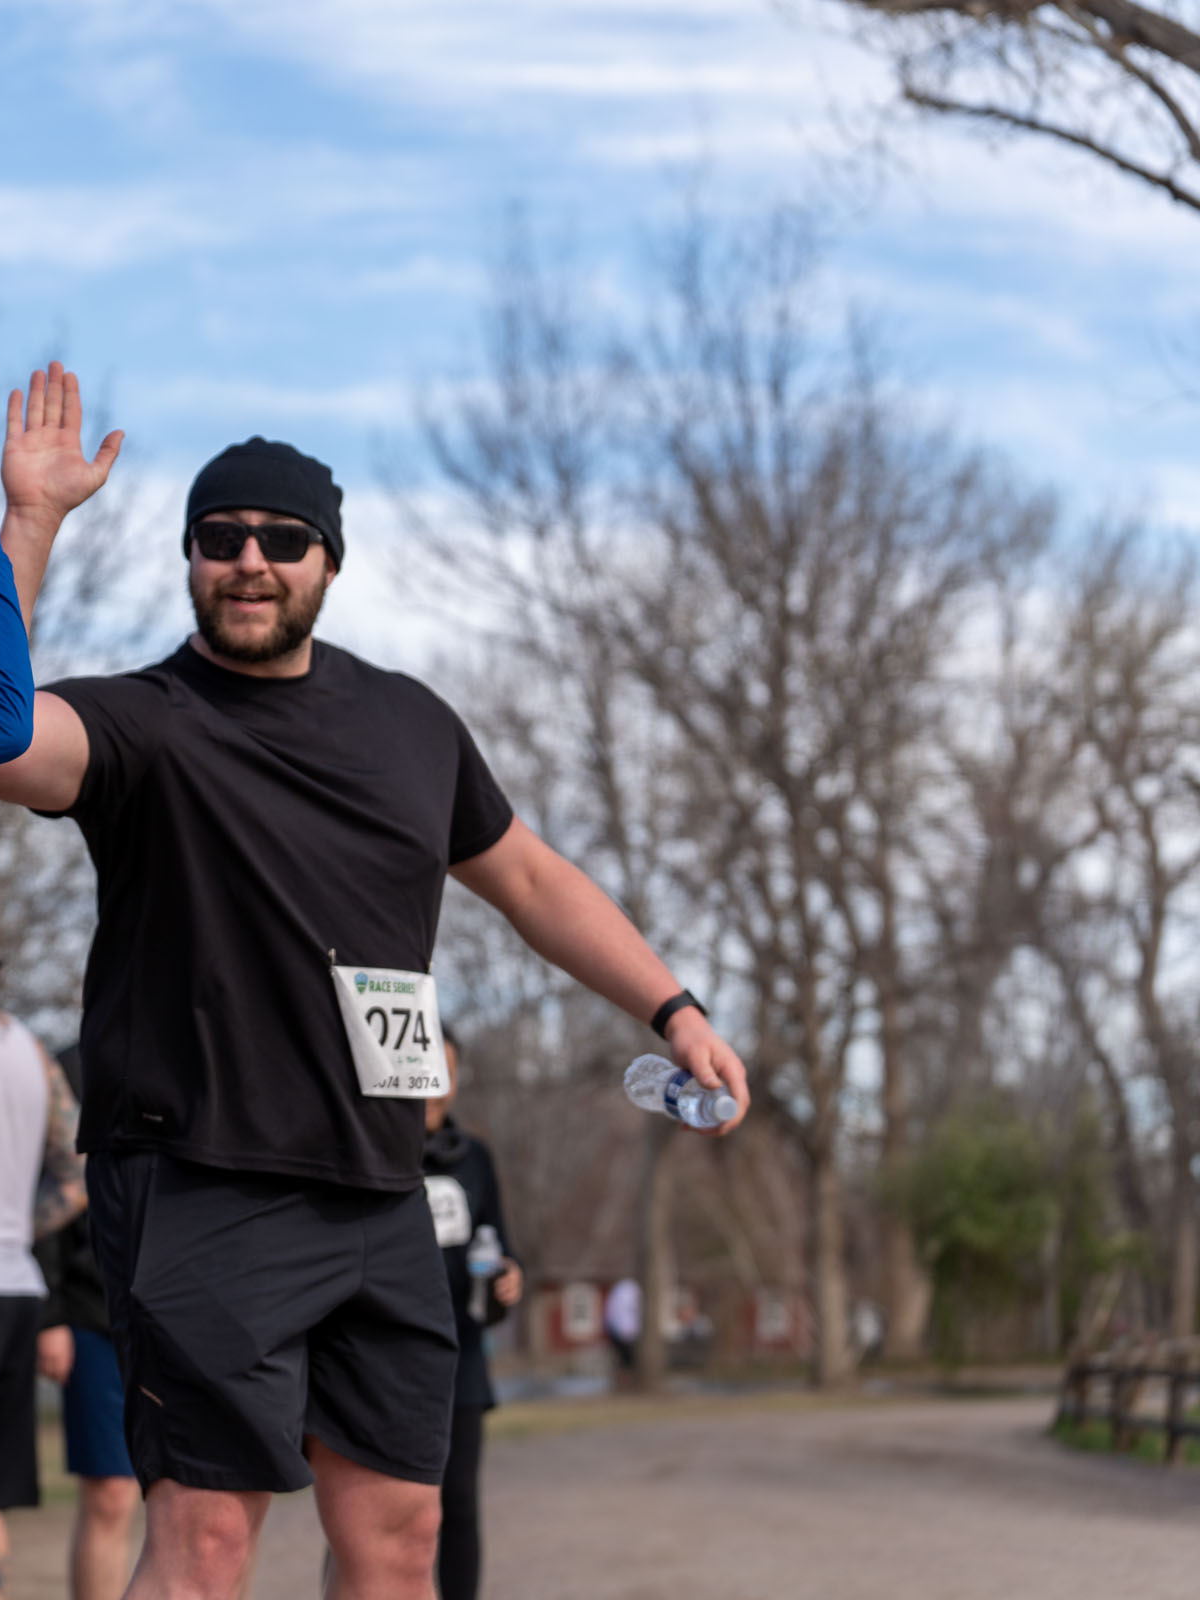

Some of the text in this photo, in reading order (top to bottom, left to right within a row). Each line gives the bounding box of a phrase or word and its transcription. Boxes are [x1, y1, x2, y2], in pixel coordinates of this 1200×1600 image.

[369, 980, 416, 995] RACE SERIES
[408, 1076, 441, 1089] 3074
